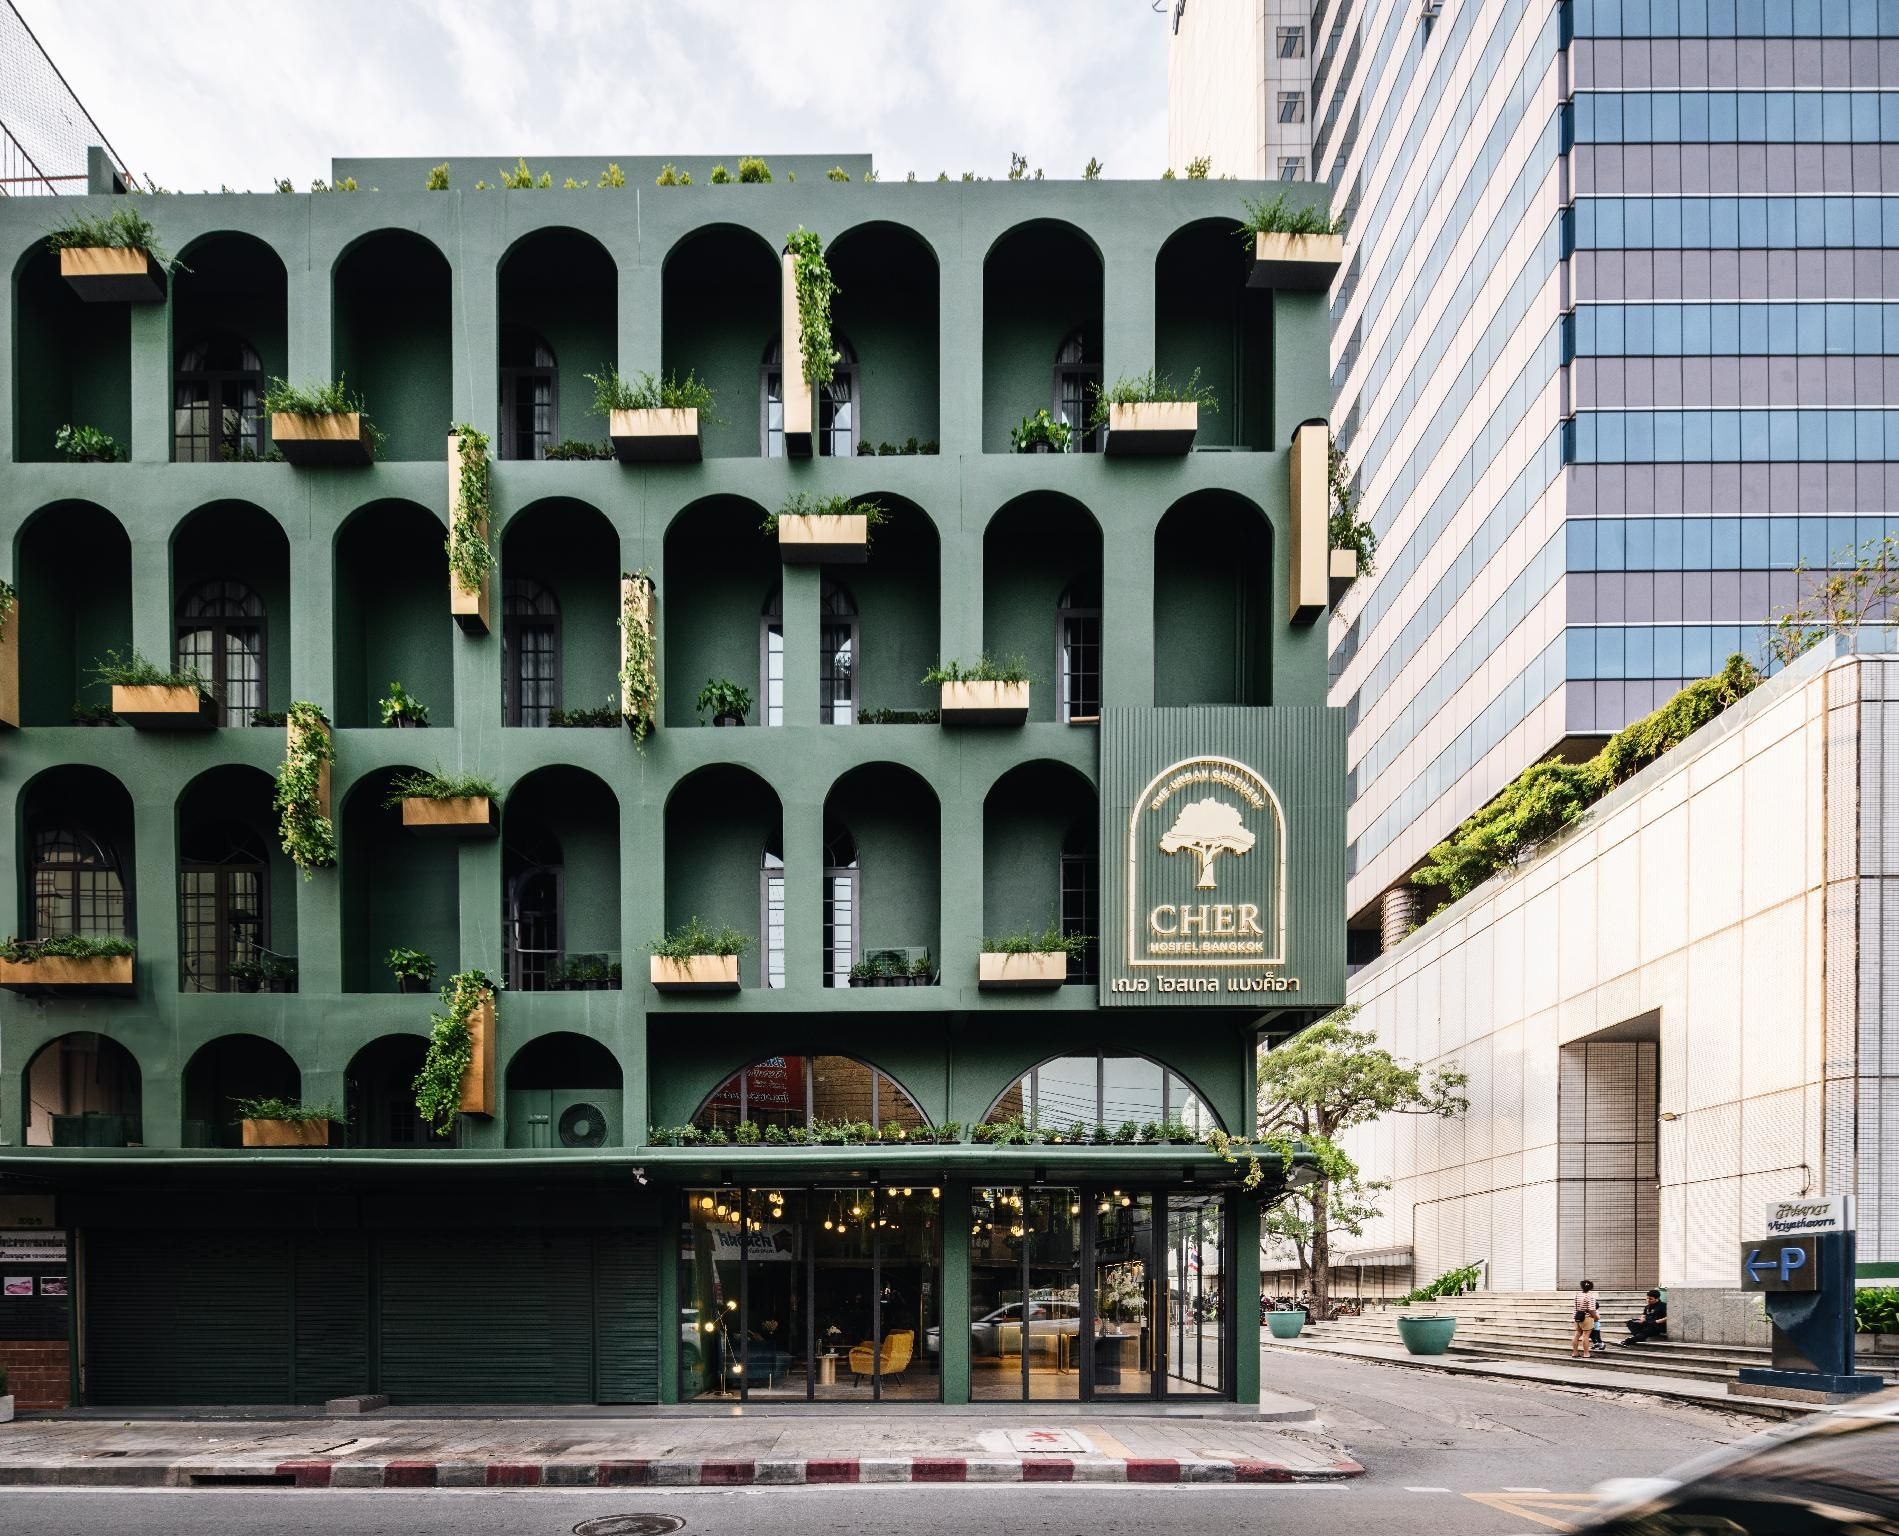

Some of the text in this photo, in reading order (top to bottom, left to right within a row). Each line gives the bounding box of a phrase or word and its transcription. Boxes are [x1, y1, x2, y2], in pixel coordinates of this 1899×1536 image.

[1151, 769, 1265, 810] THE URBAN GREENERY
[1150, 904, 1264, 935] CHER
[1150, 942, 1264, 953] HOSTEL BANGKOK
[1111, 971, 1301, 992] เฌอ โฮสเทล แบงค็อก
[1781, 1247, 1806, 1281] P
